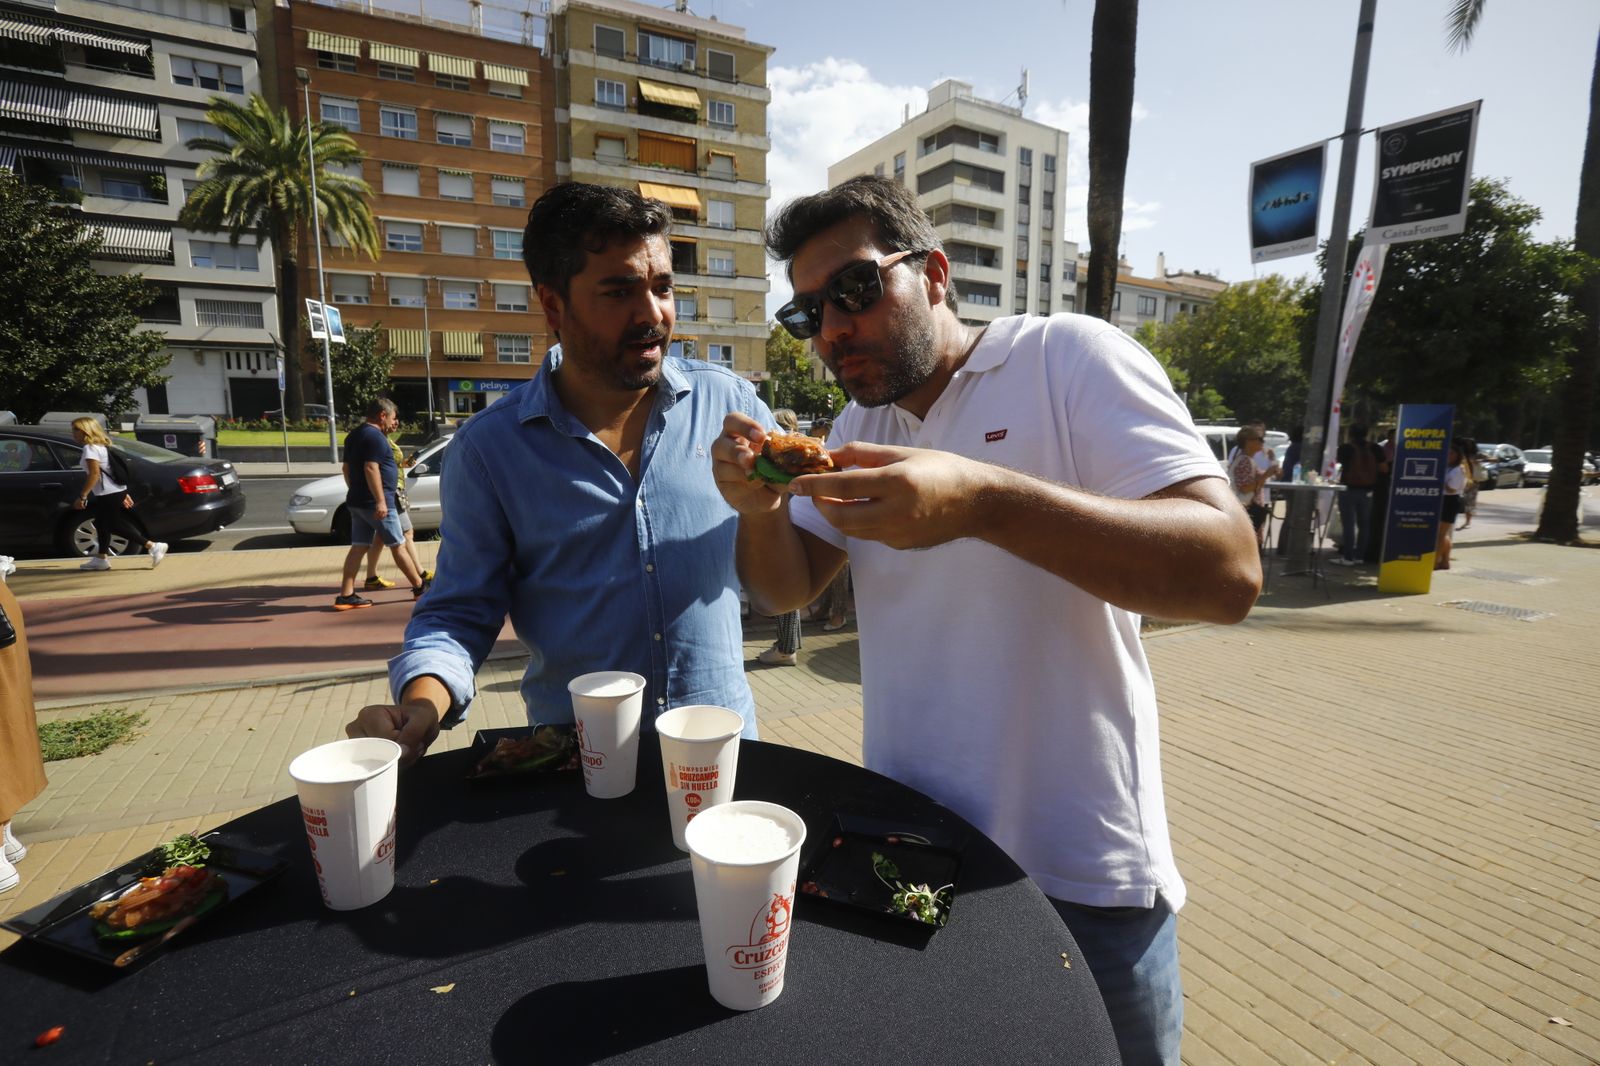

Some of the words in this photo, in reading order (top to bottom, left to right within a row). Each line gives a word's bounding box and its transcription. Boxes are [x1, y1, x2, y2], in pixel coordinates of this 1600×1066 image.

[1382, 151, 1463, 179] SYMPHONY
[1382, 223, 1449, 239] CaixaForum
[480, 381, 509, 390] pelayo
[1403, 428, 1446, 439] COMPRA
[1404, 440, 1442, 450] ONLINE
[1395, 487, 1440, 496] MAKRO.ES
[679, 771, 719, 781] CRUZCAMPO
[691, 781, 718, 791] HUELLA
